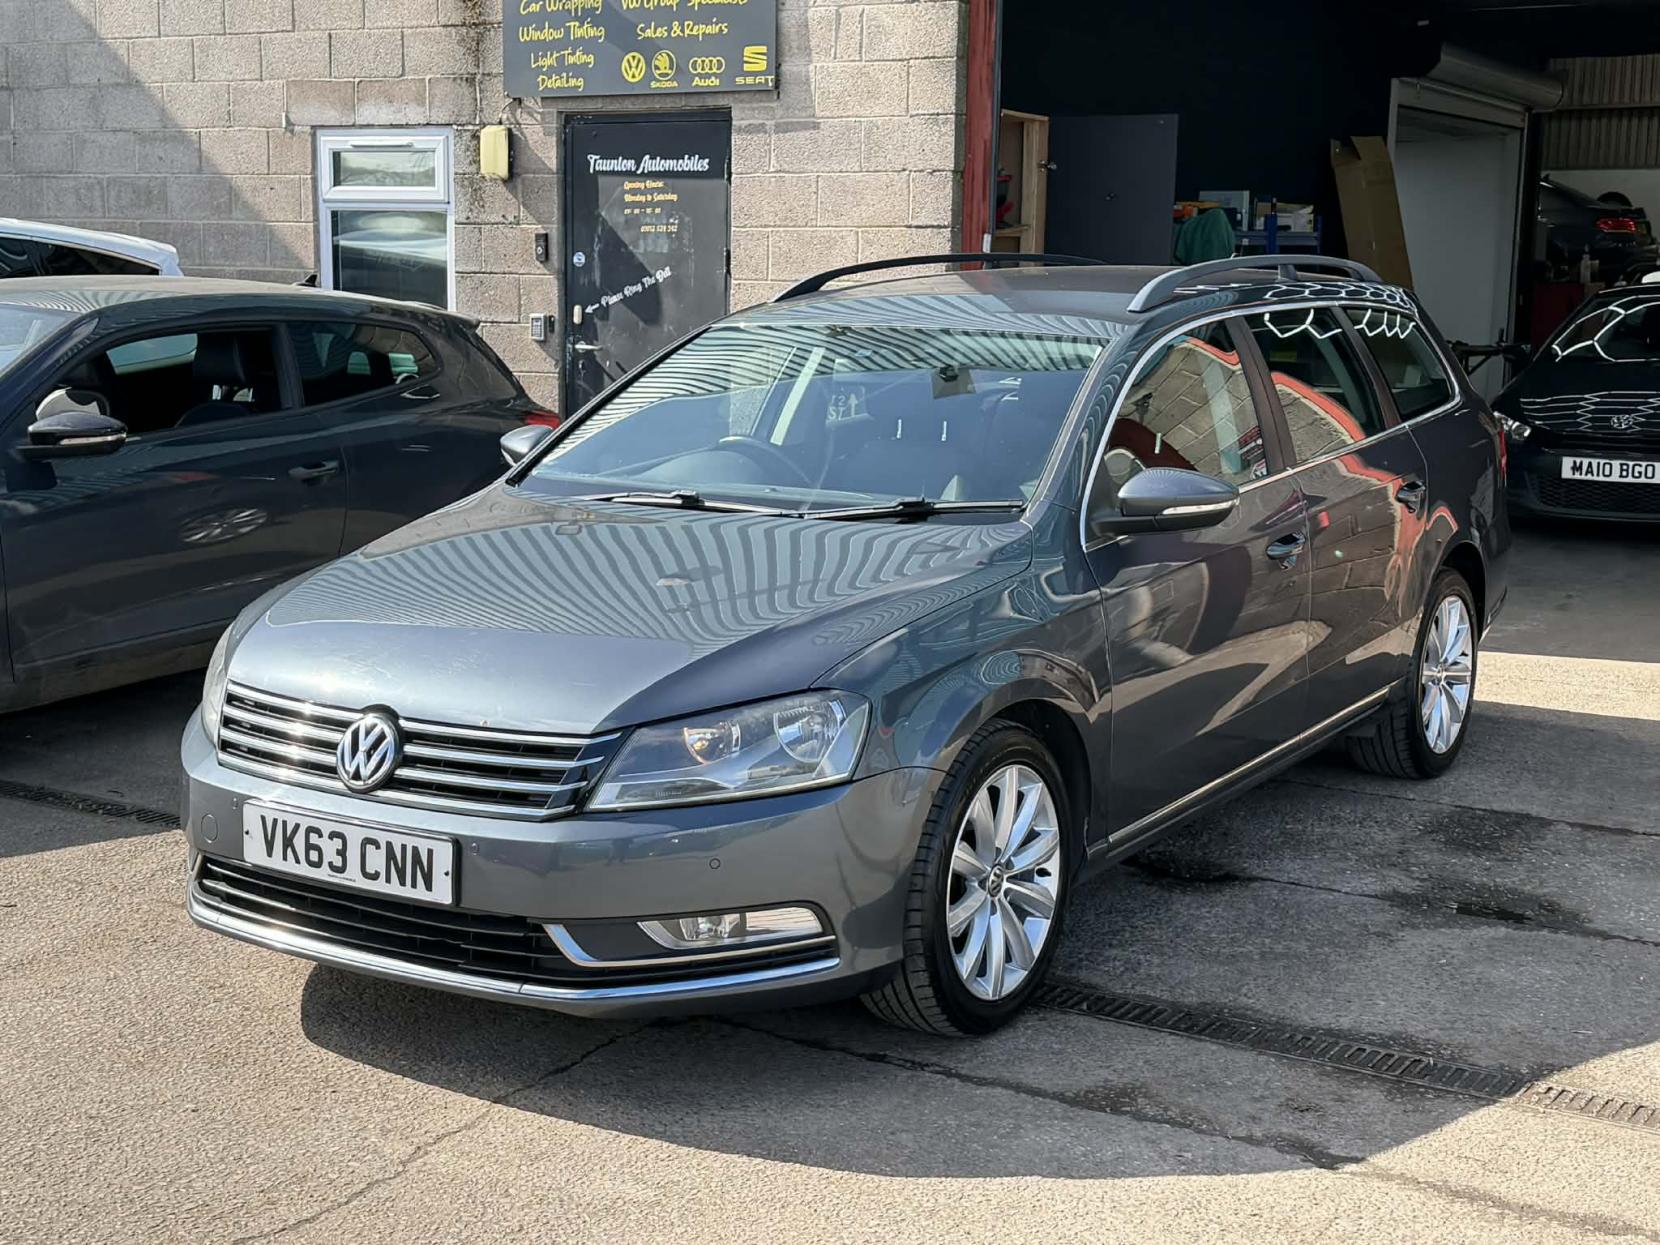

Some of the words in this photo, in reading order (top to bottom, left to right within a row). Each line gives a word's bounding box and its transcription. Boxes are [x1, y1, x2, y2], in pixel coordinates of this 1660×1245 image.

[520, 0, 544, 15] Car
[546, 0, 603, 16] Wrapping
[519, 21, 564, 42] Window
[565, 17, 605, 43] Tinting
[636, 22, 668, 40] Sales
[671, 21, 684, 37] &
[684, 17, 728, 41] Repairs
[531, 50, 559, 71] Light
[560, 47, 595, 68] Tinting
[537, 72, 584, 91] Detailing
[692, 77, 720, 86] Audi
[735, 76, 774, 86] SEAT
[587, 154, 637, 174] Taunton
[637, 154, 710, 174] Automobiles
[601, 291, 624, 307] Please
[624, 283, 642, 297] Ring
[642, 275, 656, 288] The
[1570, 460, 1613, 478] MA10
[1618, 462, 1656, 480] BGO
[260, 814, 348, 874] VK63
[360, 836, 434, 892] CNN
